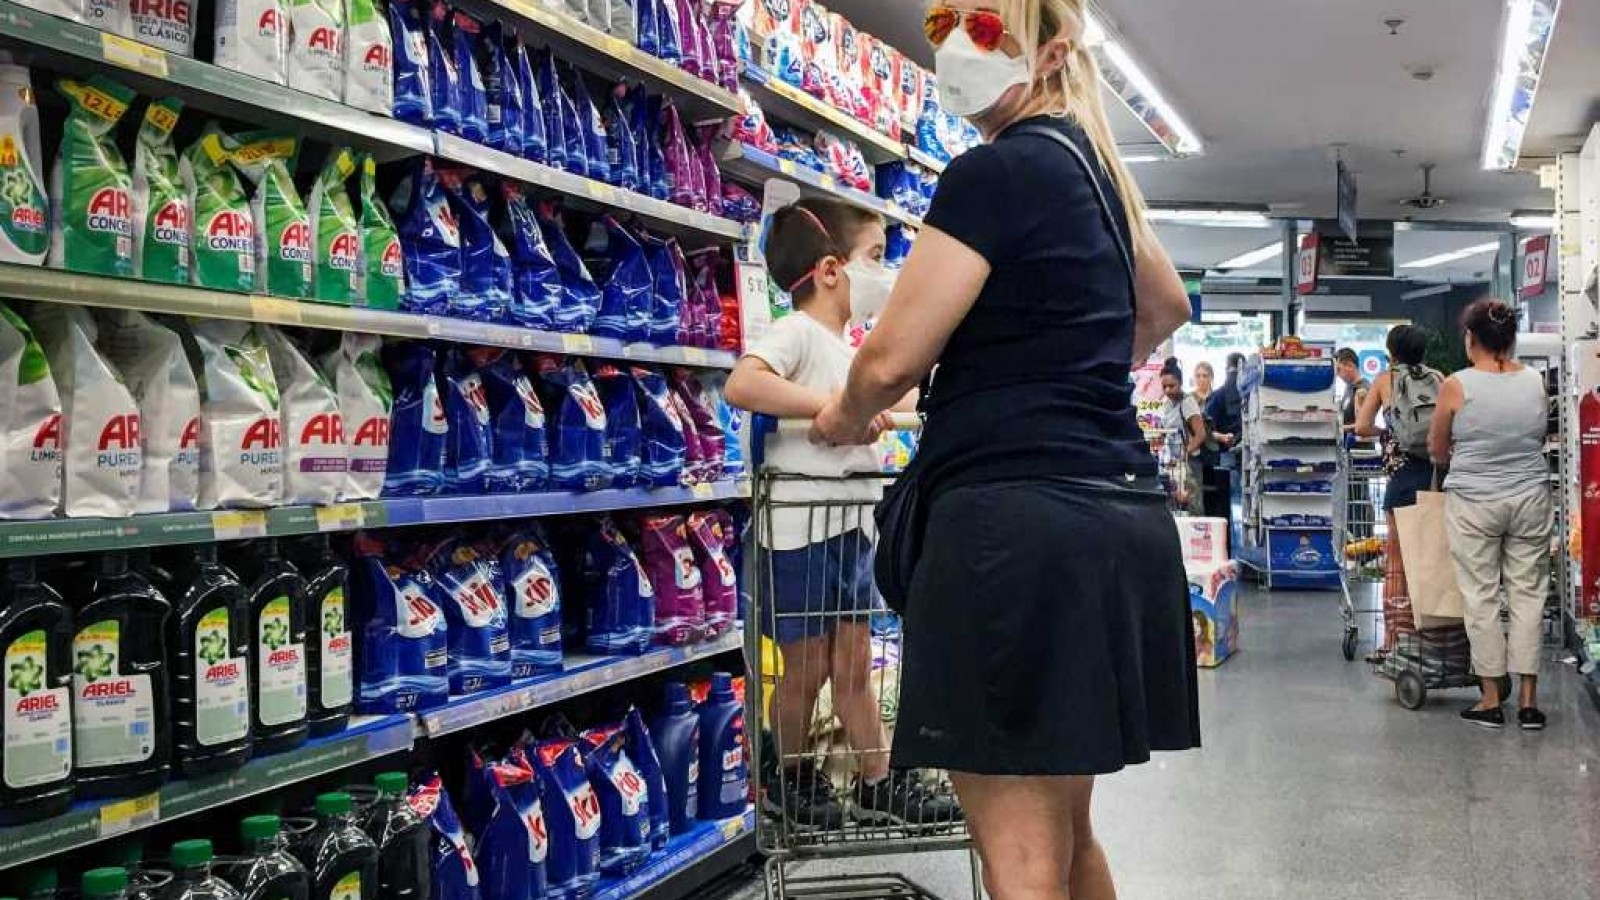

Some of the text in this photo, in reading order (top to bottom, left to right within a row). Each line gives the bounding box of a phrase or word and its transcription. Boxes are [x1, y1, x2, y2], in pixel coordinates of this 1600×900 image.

[1527, 257, 1540, 278] 02
[268, 649, 299, 664] ARIEL
[205, 663, 240, 680] ARIEL
[82, 680, 137, 698] ARIEL
[17, 694, 59, 712] ARIEL
